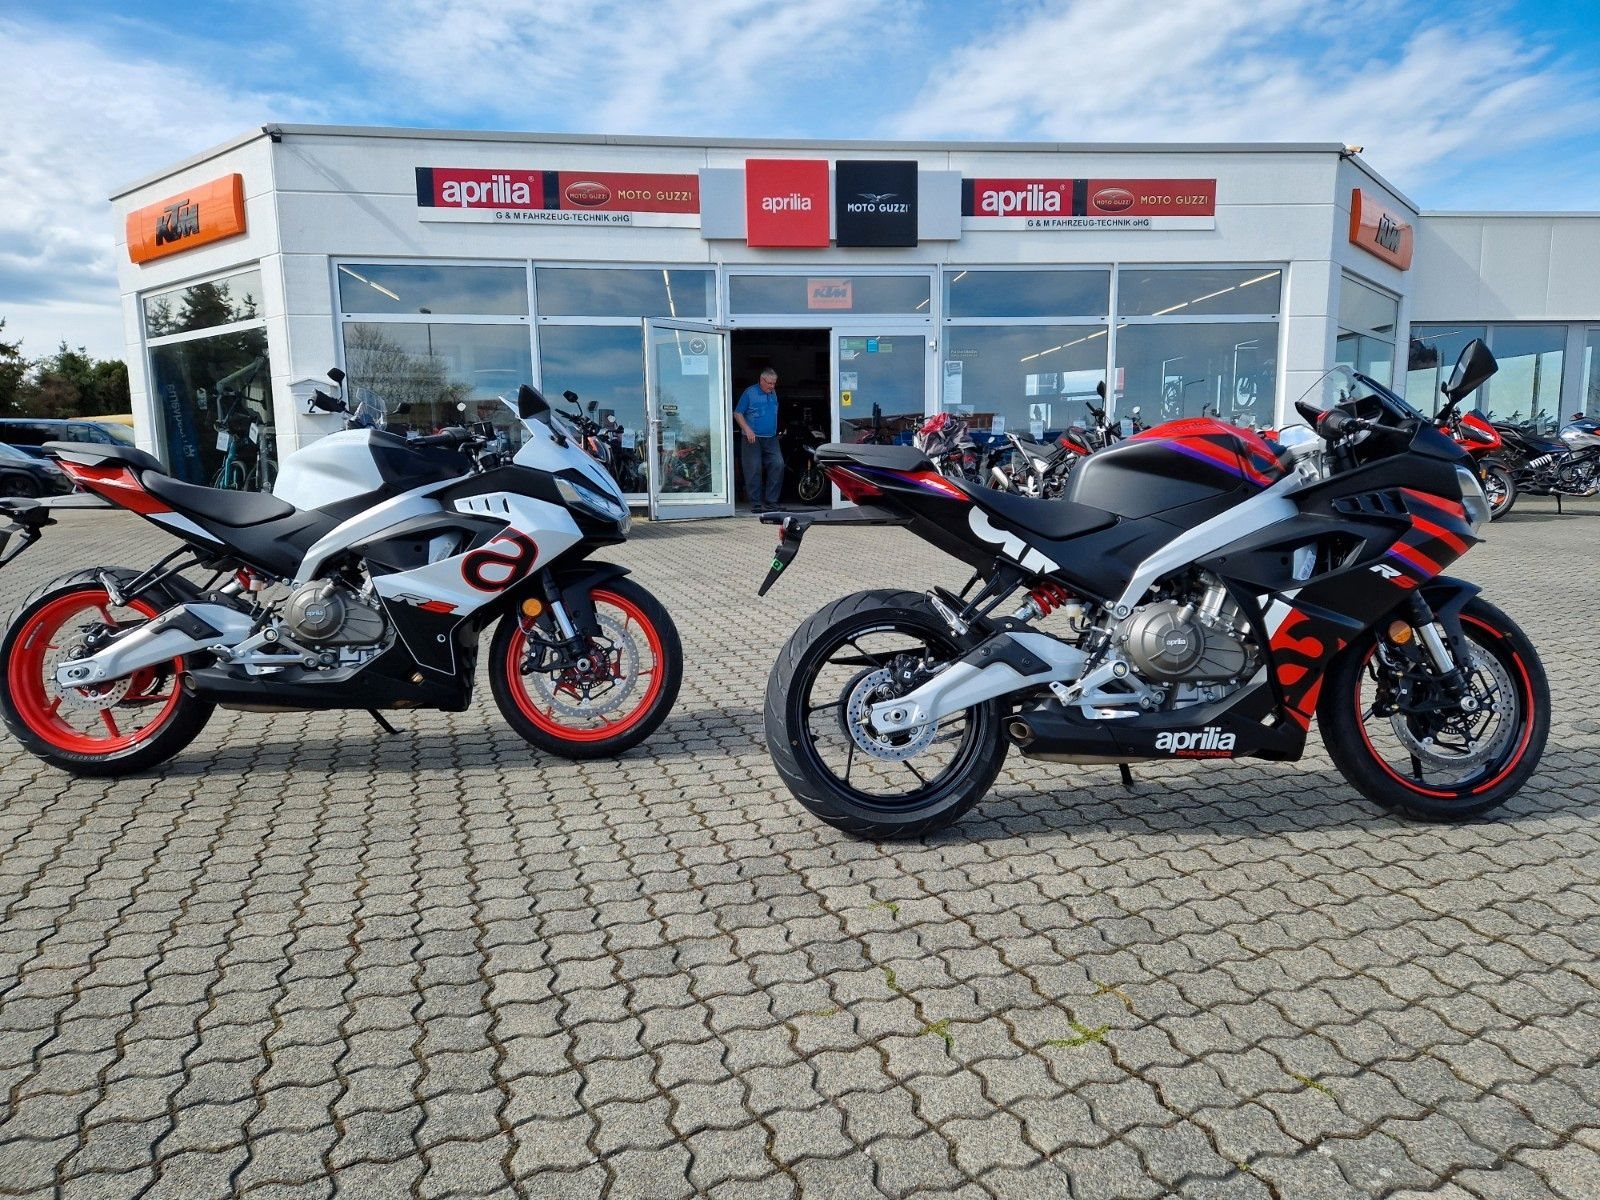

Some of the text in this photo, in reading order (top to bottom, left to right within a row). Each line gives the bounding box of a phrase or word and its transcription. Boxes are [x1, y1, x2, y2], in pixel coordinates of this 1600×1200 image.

[442, 174, 531, 208] aprilia
[617, 190, 693, 202] MOTO GUZZI
[981, 183, 1061, 216] aprilia
[1140, 195, 1208, 205] MOTO GUZZI
[762, 193, 812, 213] aprilia
[847, 203, 909, 213] MOTO GUZZI
[156, 199, 200, 246] KTM
[496, 211, 630, 223] G & M FAHRZEUG-TECHNIK oHG
[1027, 219, 1150, 227] G & M FAHRZEUG-TECHNIK oHG
[1375, 213, 1400, 254] KTM
[1369, 563, 1418, 589] RS
[390, 592, 459, 614] RS
[1155, 727, 1236, 753] aprilia
